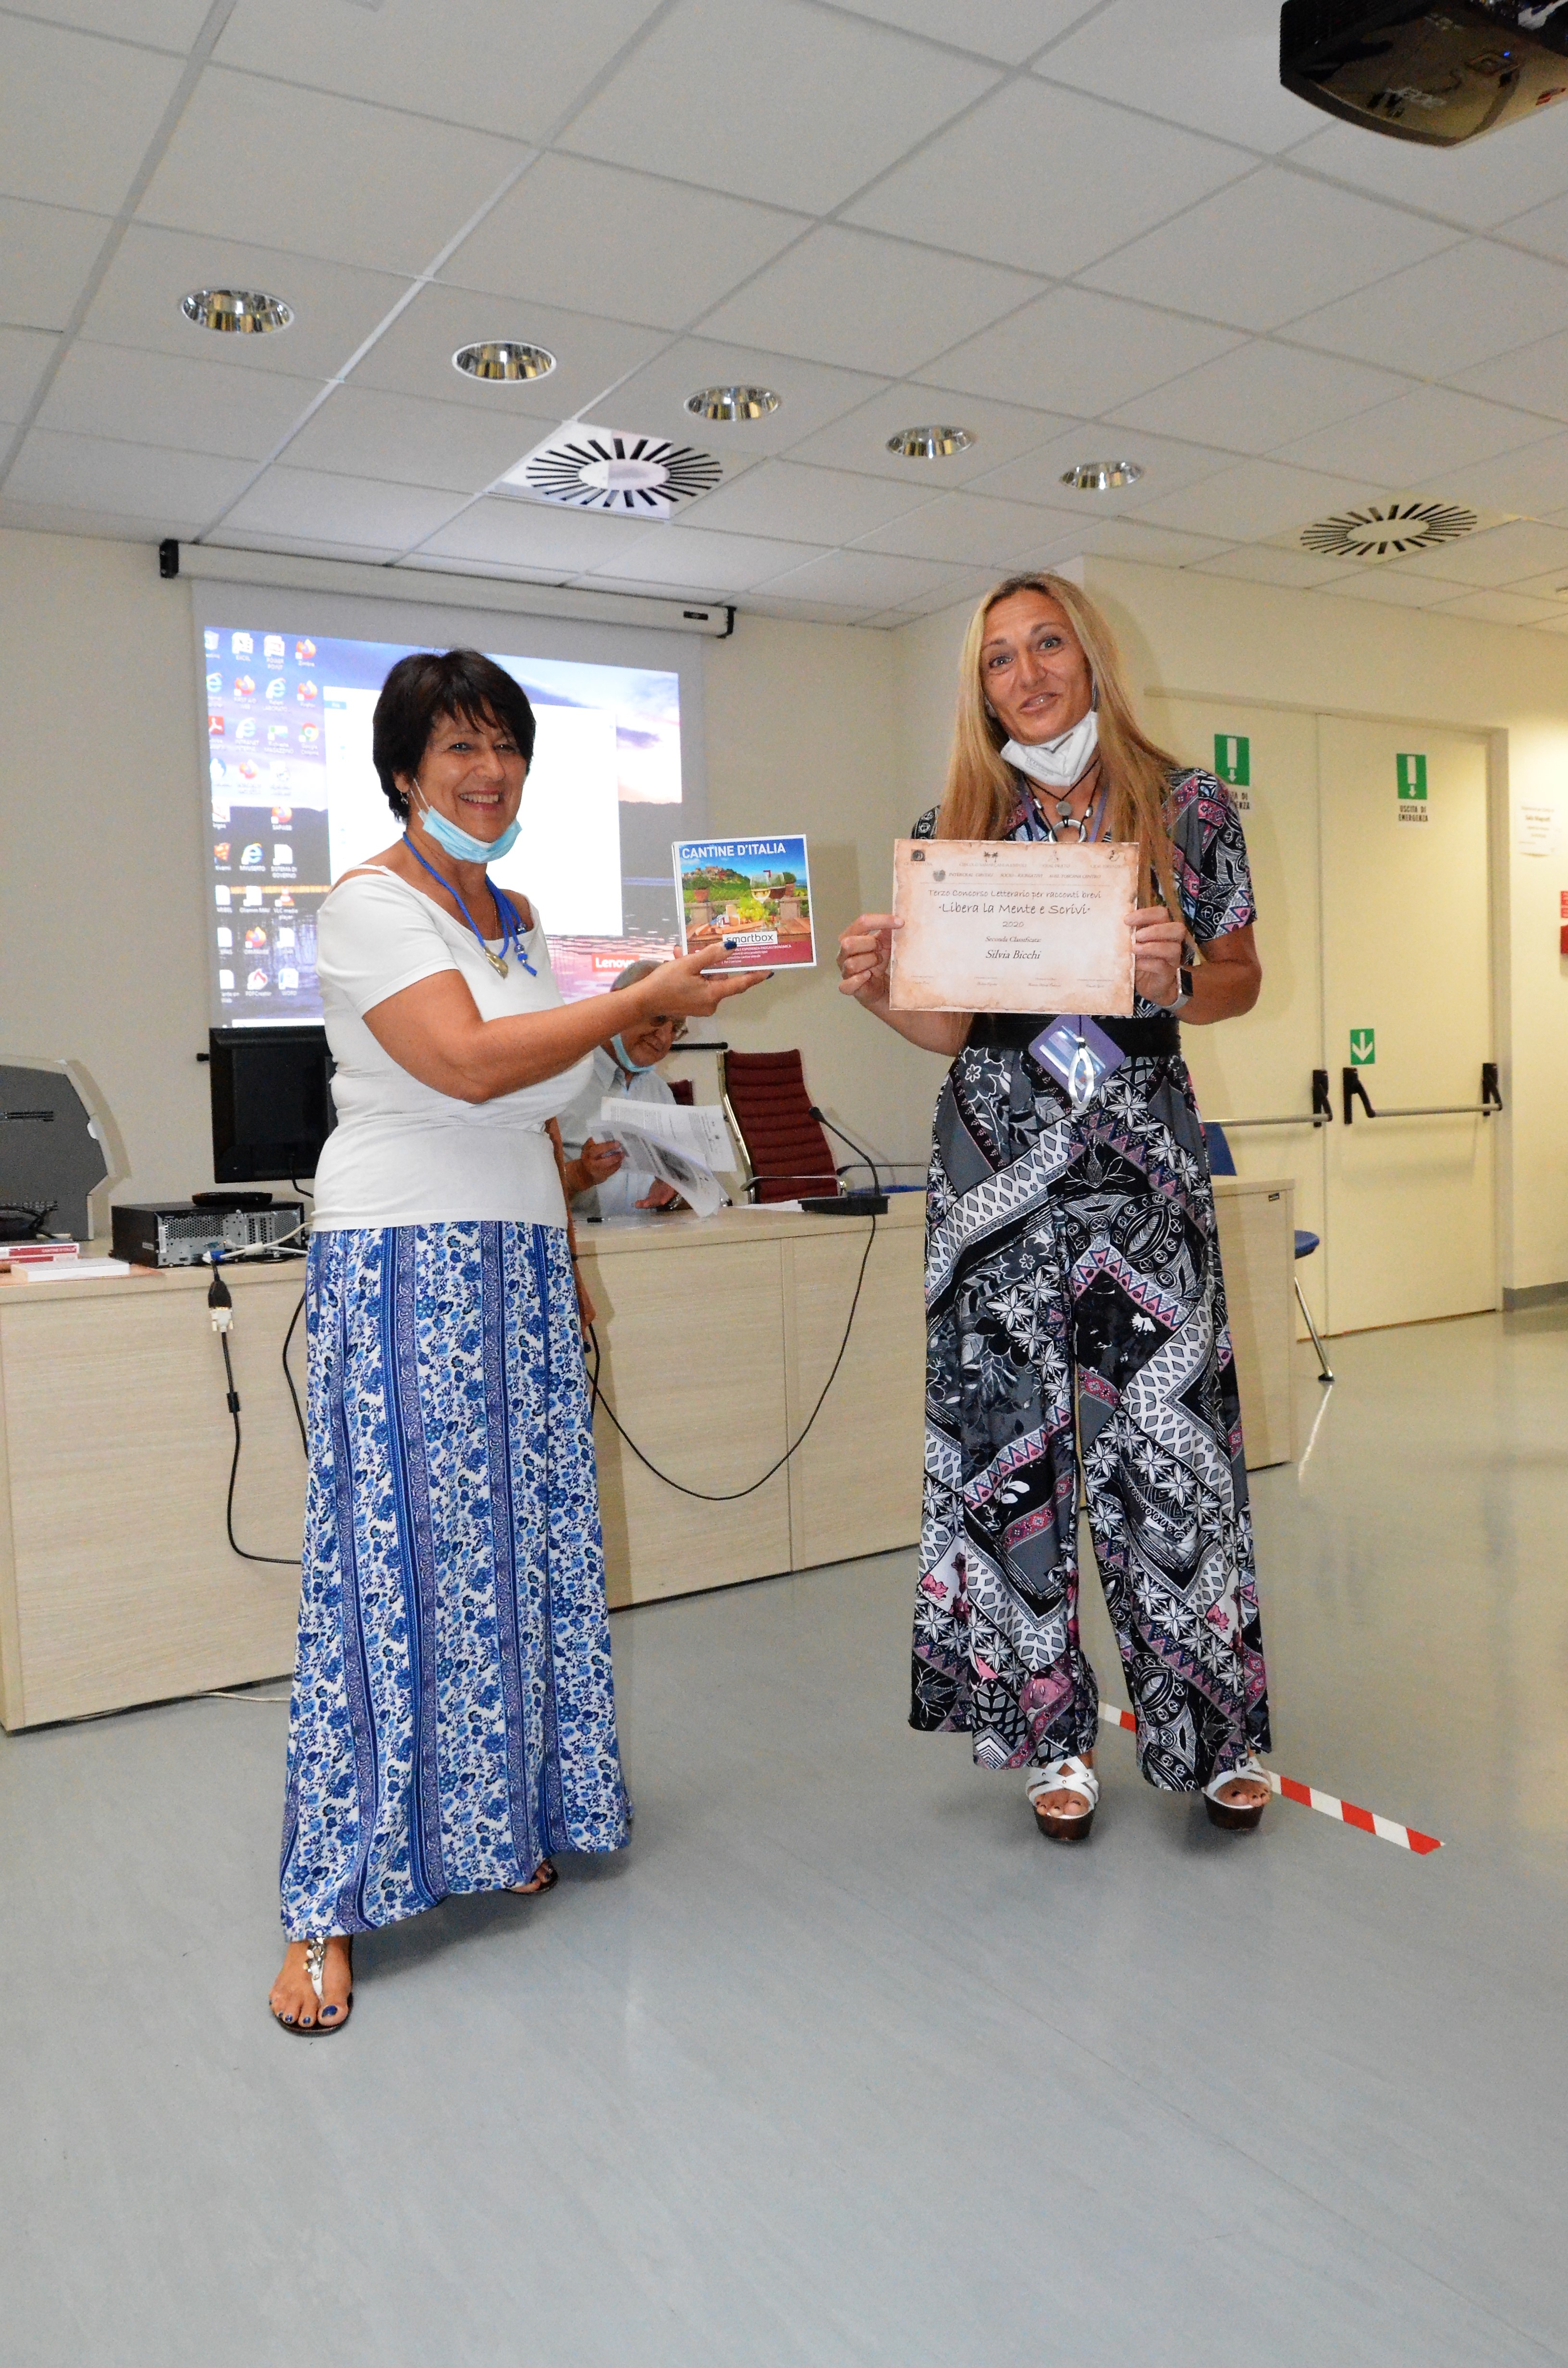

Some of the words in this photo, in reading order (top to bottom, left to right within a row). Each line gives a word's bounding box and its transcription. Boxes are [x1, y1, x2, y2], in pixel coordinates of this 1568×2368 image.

[682, 845, 735, 859] CANTINE
[737, 842, 786, 856] D'ITALIA
[1032, 891, 1044, 900] per
[983, 902, 994, 913] la
[999, 904, 1036, 914] Mente
[1040, 906, 1045, 914] e
[985, 950, 1010, 959] Silvia
[1013, 950, 1041, 960] Bicchi
